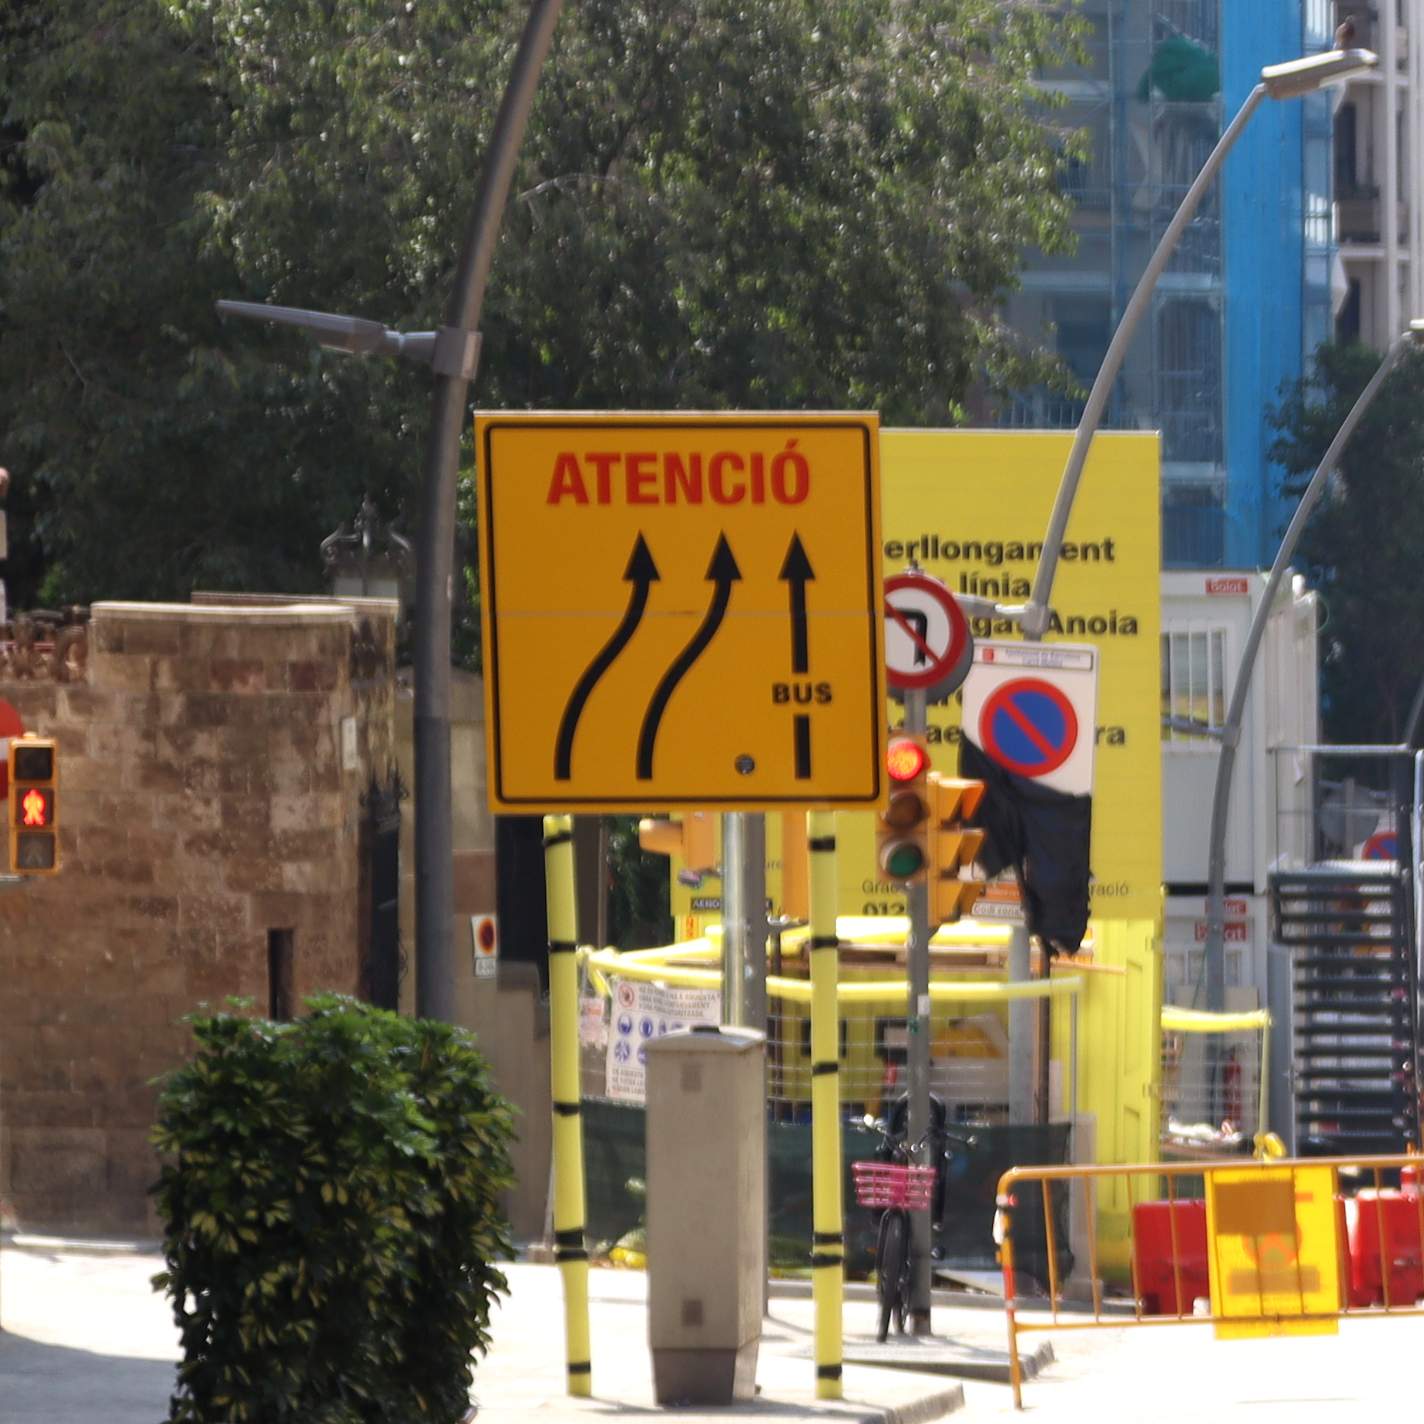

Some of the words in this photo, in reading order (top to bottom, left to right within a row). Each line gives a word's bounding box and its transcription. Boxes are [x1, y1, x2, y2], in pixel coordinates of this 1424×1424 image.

[546, 439, 810, 505] ATENCIÓ
[883, 535, 1116, 566] erllongaent
[959, 571, 1031, 598] línia
[772, 683, 832, 705] BUS
